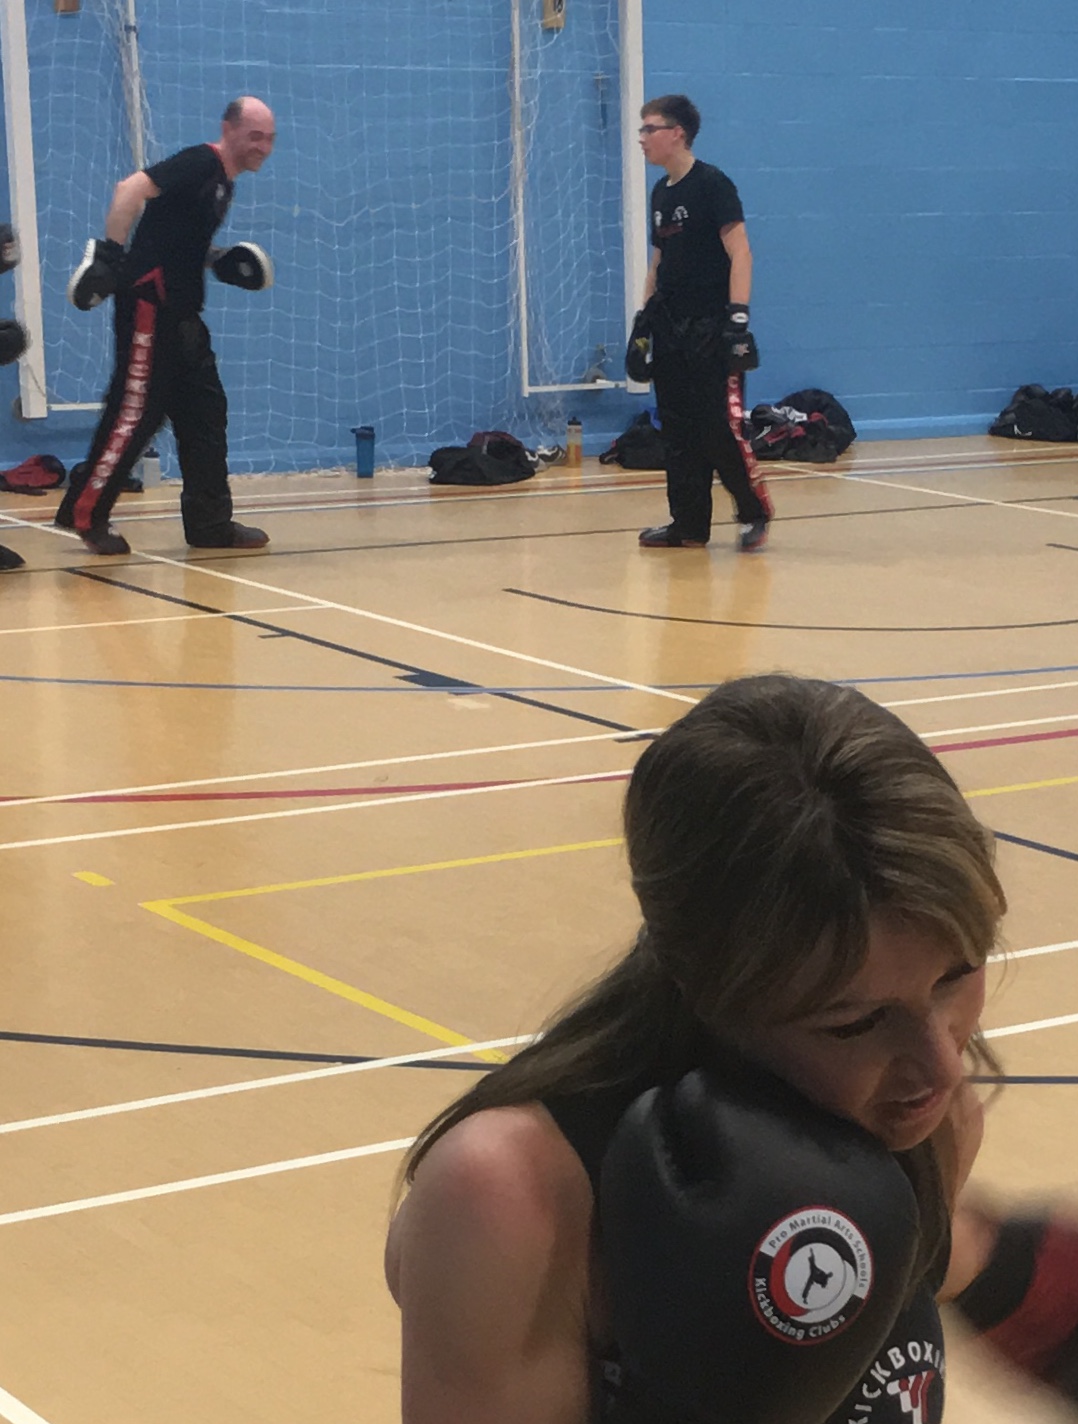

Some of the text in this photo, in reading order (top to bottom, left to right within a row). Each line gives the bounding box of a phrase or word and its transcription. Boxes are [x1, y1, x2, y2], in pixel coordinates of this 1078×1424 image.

[768, 1215, 869, 1288] Pro Martial Arts Schools
[754, 1277, 846, 1340] Kickboxing Clubs
